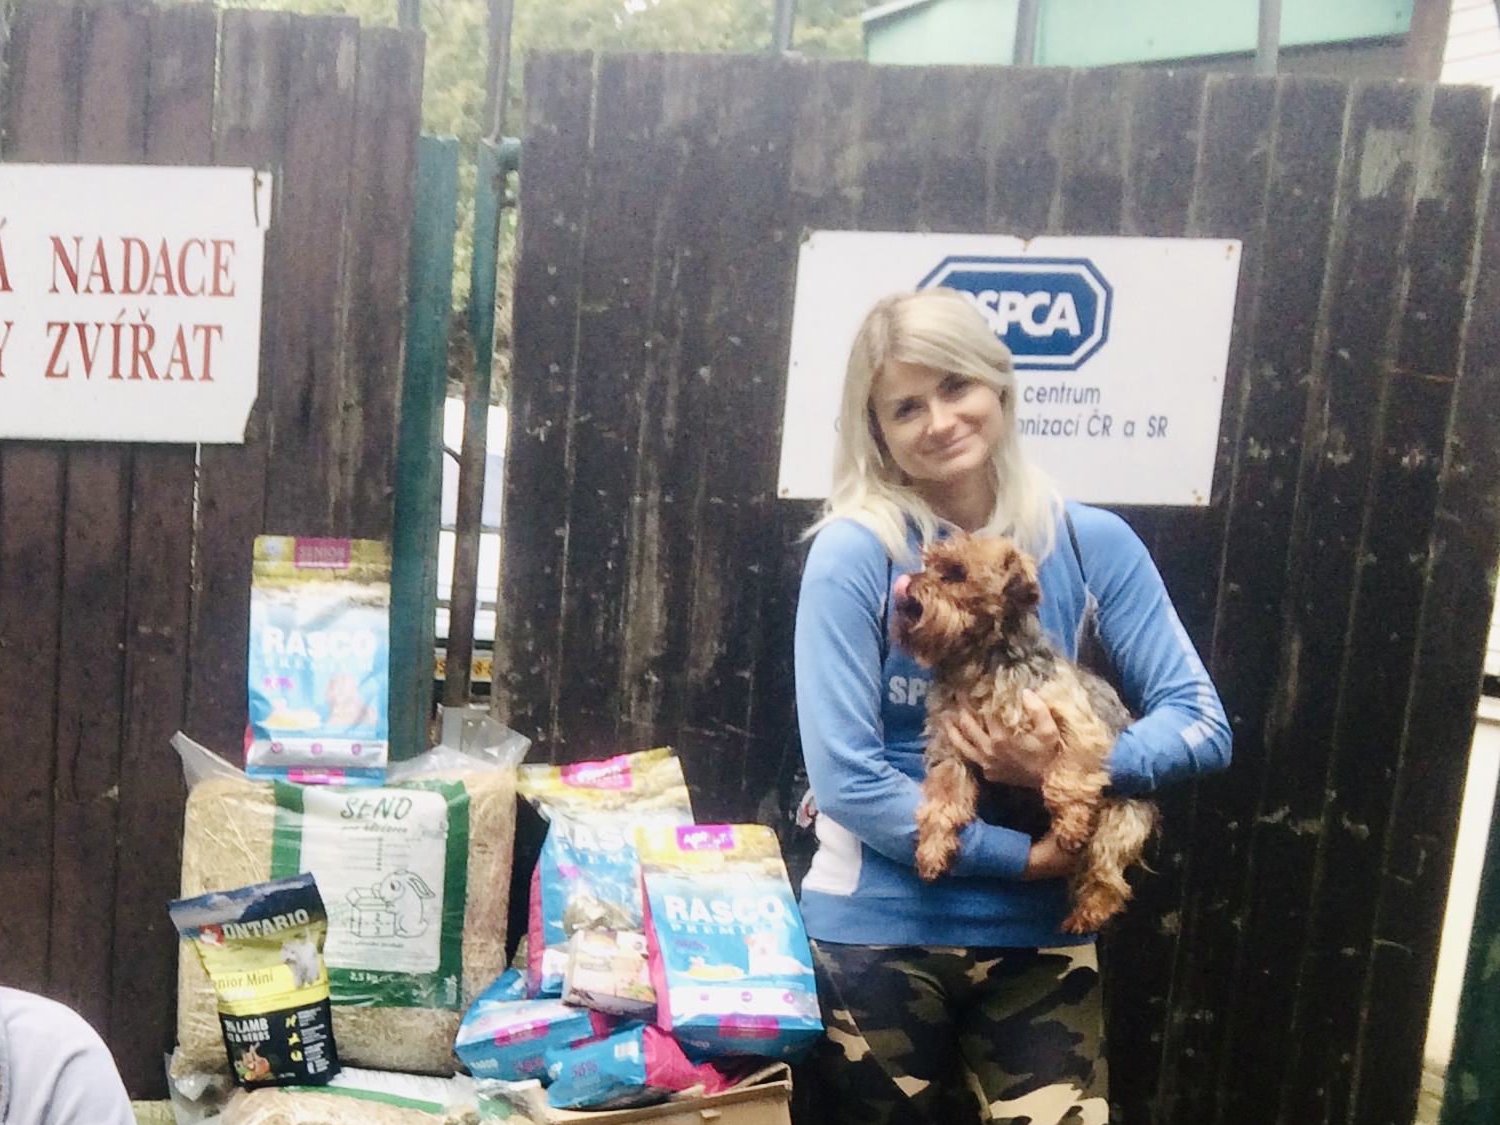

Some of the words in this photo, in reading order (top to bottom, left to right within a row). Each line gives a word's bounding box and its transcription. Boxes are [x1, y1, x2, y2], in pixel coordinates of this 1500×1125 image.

[49, 234, 236, 298] NADACE
[965, 291, 1081, 338] SPCA
[45, 309, 223, 382] ZVÍŘAT
[1024, 383, 1101, 405] centrum
[1087, 410, 1113, 438] ČR
[1122, 420, 1135, 435] a
[1146, 416, 1169, 438] SR
[263, 625, 376, 660] RASCO
[340, 796, 413, 820] SENO
[222, 908, 310, 941] ONTARIO
[664, 894, 786, 925] RASCO
[246, 969, 274, 986] Mini
[236, 1017, 269, 1033] LAMB
